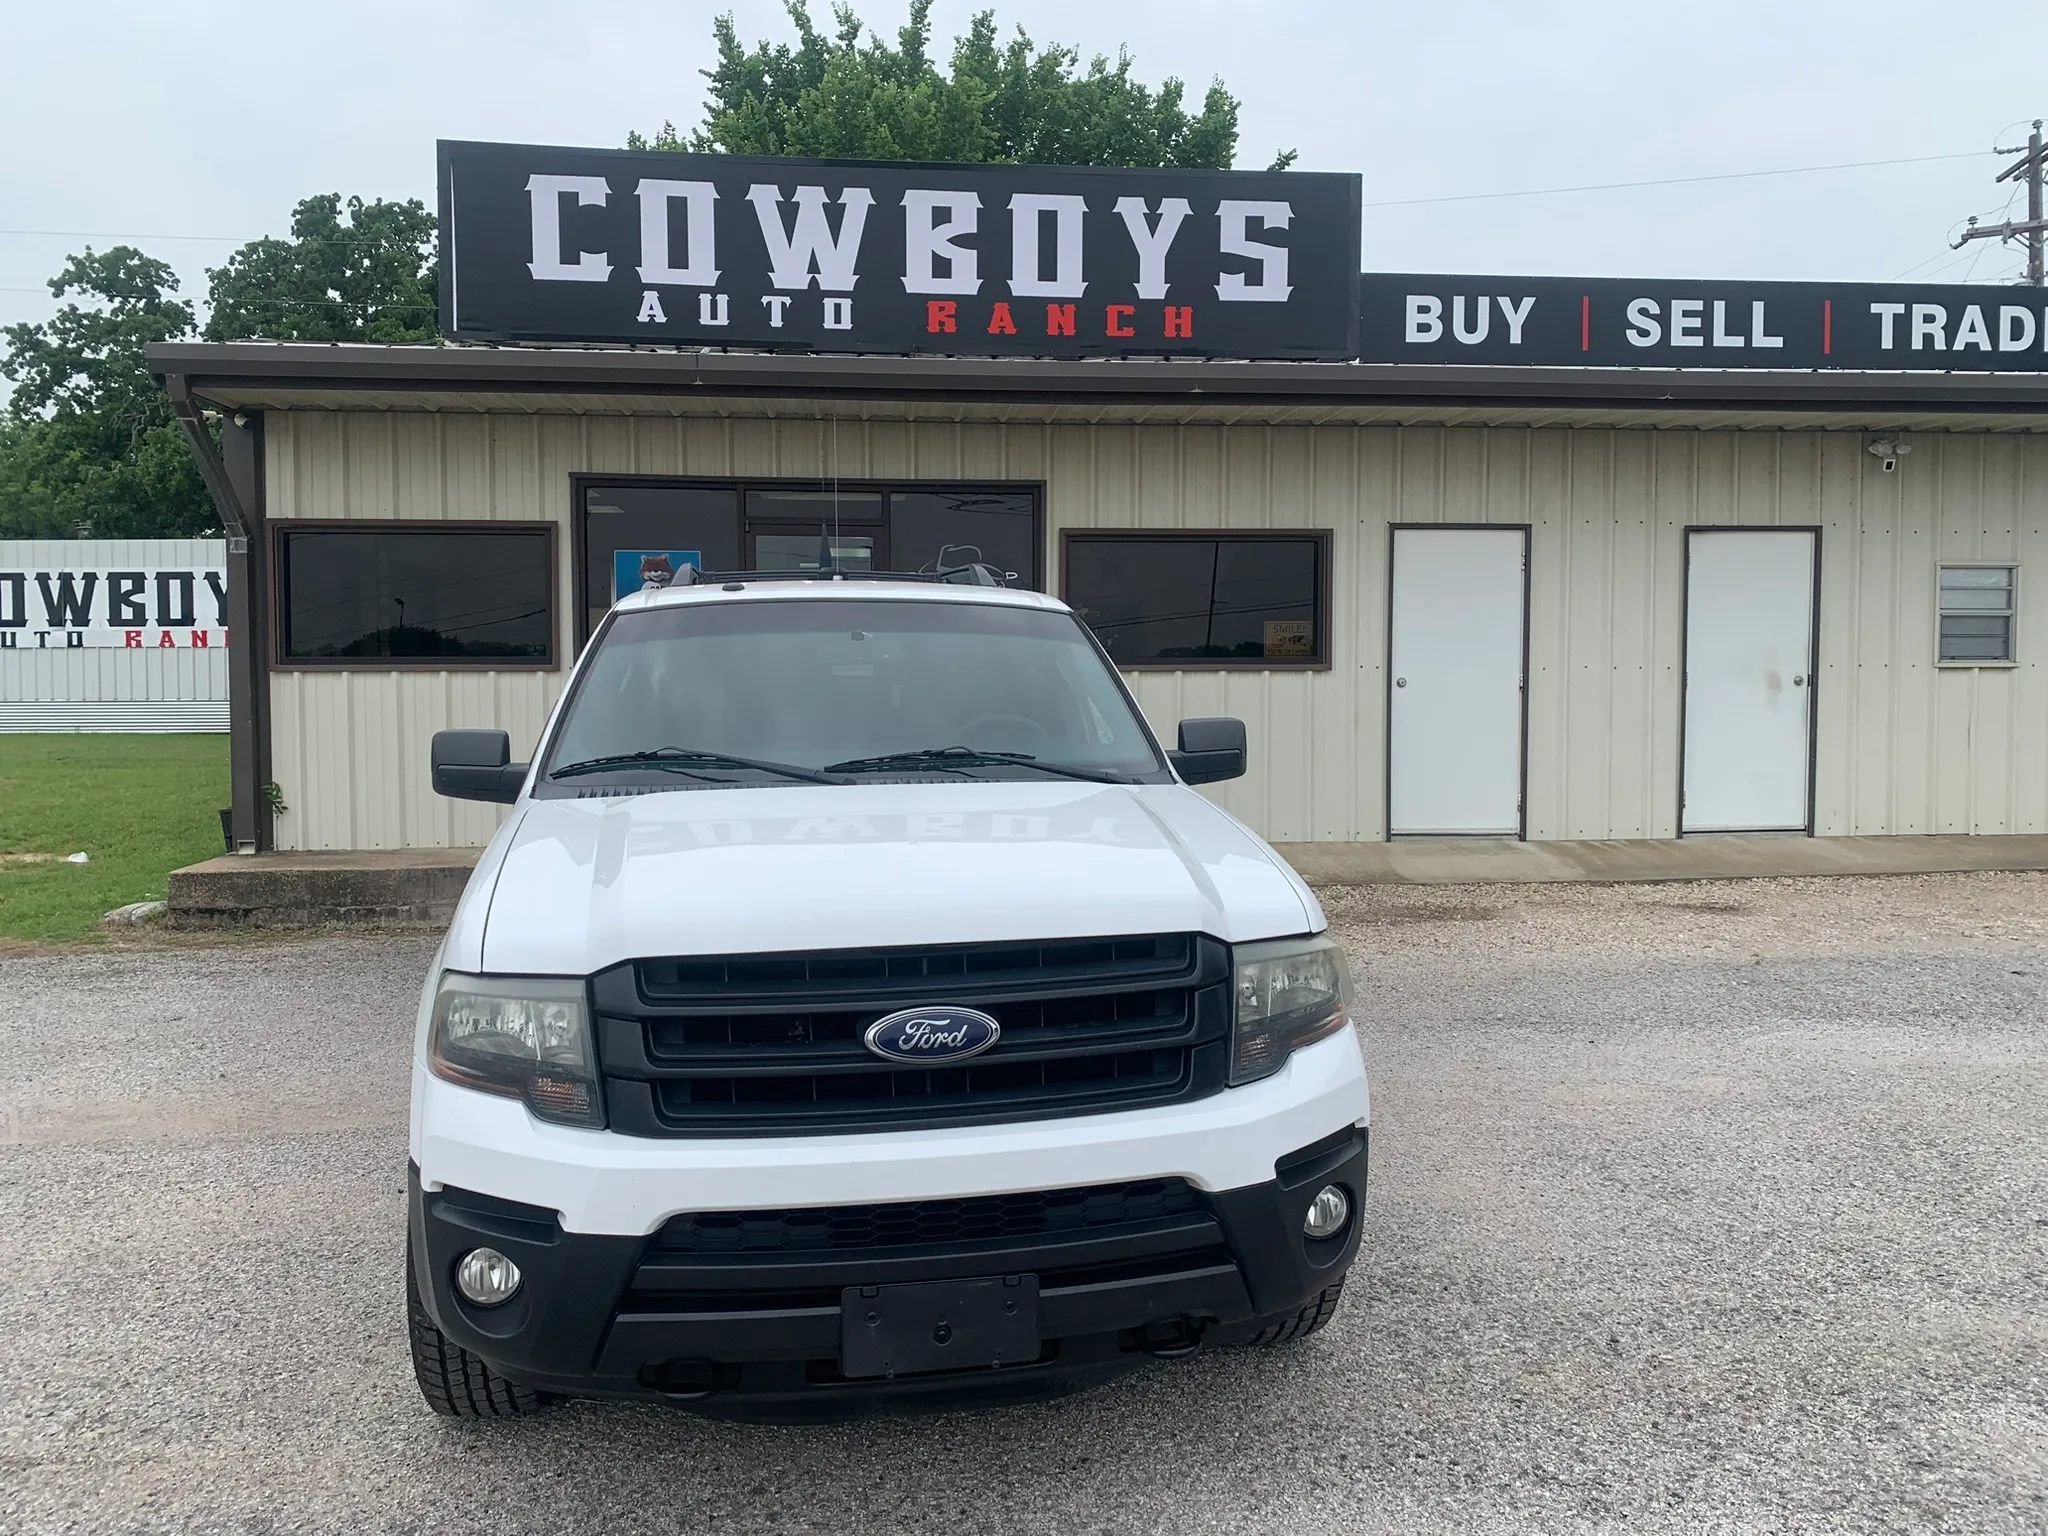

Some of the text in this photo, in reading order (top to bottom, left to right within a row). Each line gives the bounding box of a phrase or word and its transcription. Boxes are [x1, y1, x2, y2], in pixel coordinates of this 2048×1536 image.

[525, 173, 1296, 303] COWBOYS
[636, 290, 1194, 338] AUTO RANCH
[1405, 294, 2048, 353] BUY SELL TRAD
[124, 630, 229, 649] RAN
[899, 1018, 969, 1051] Ford
